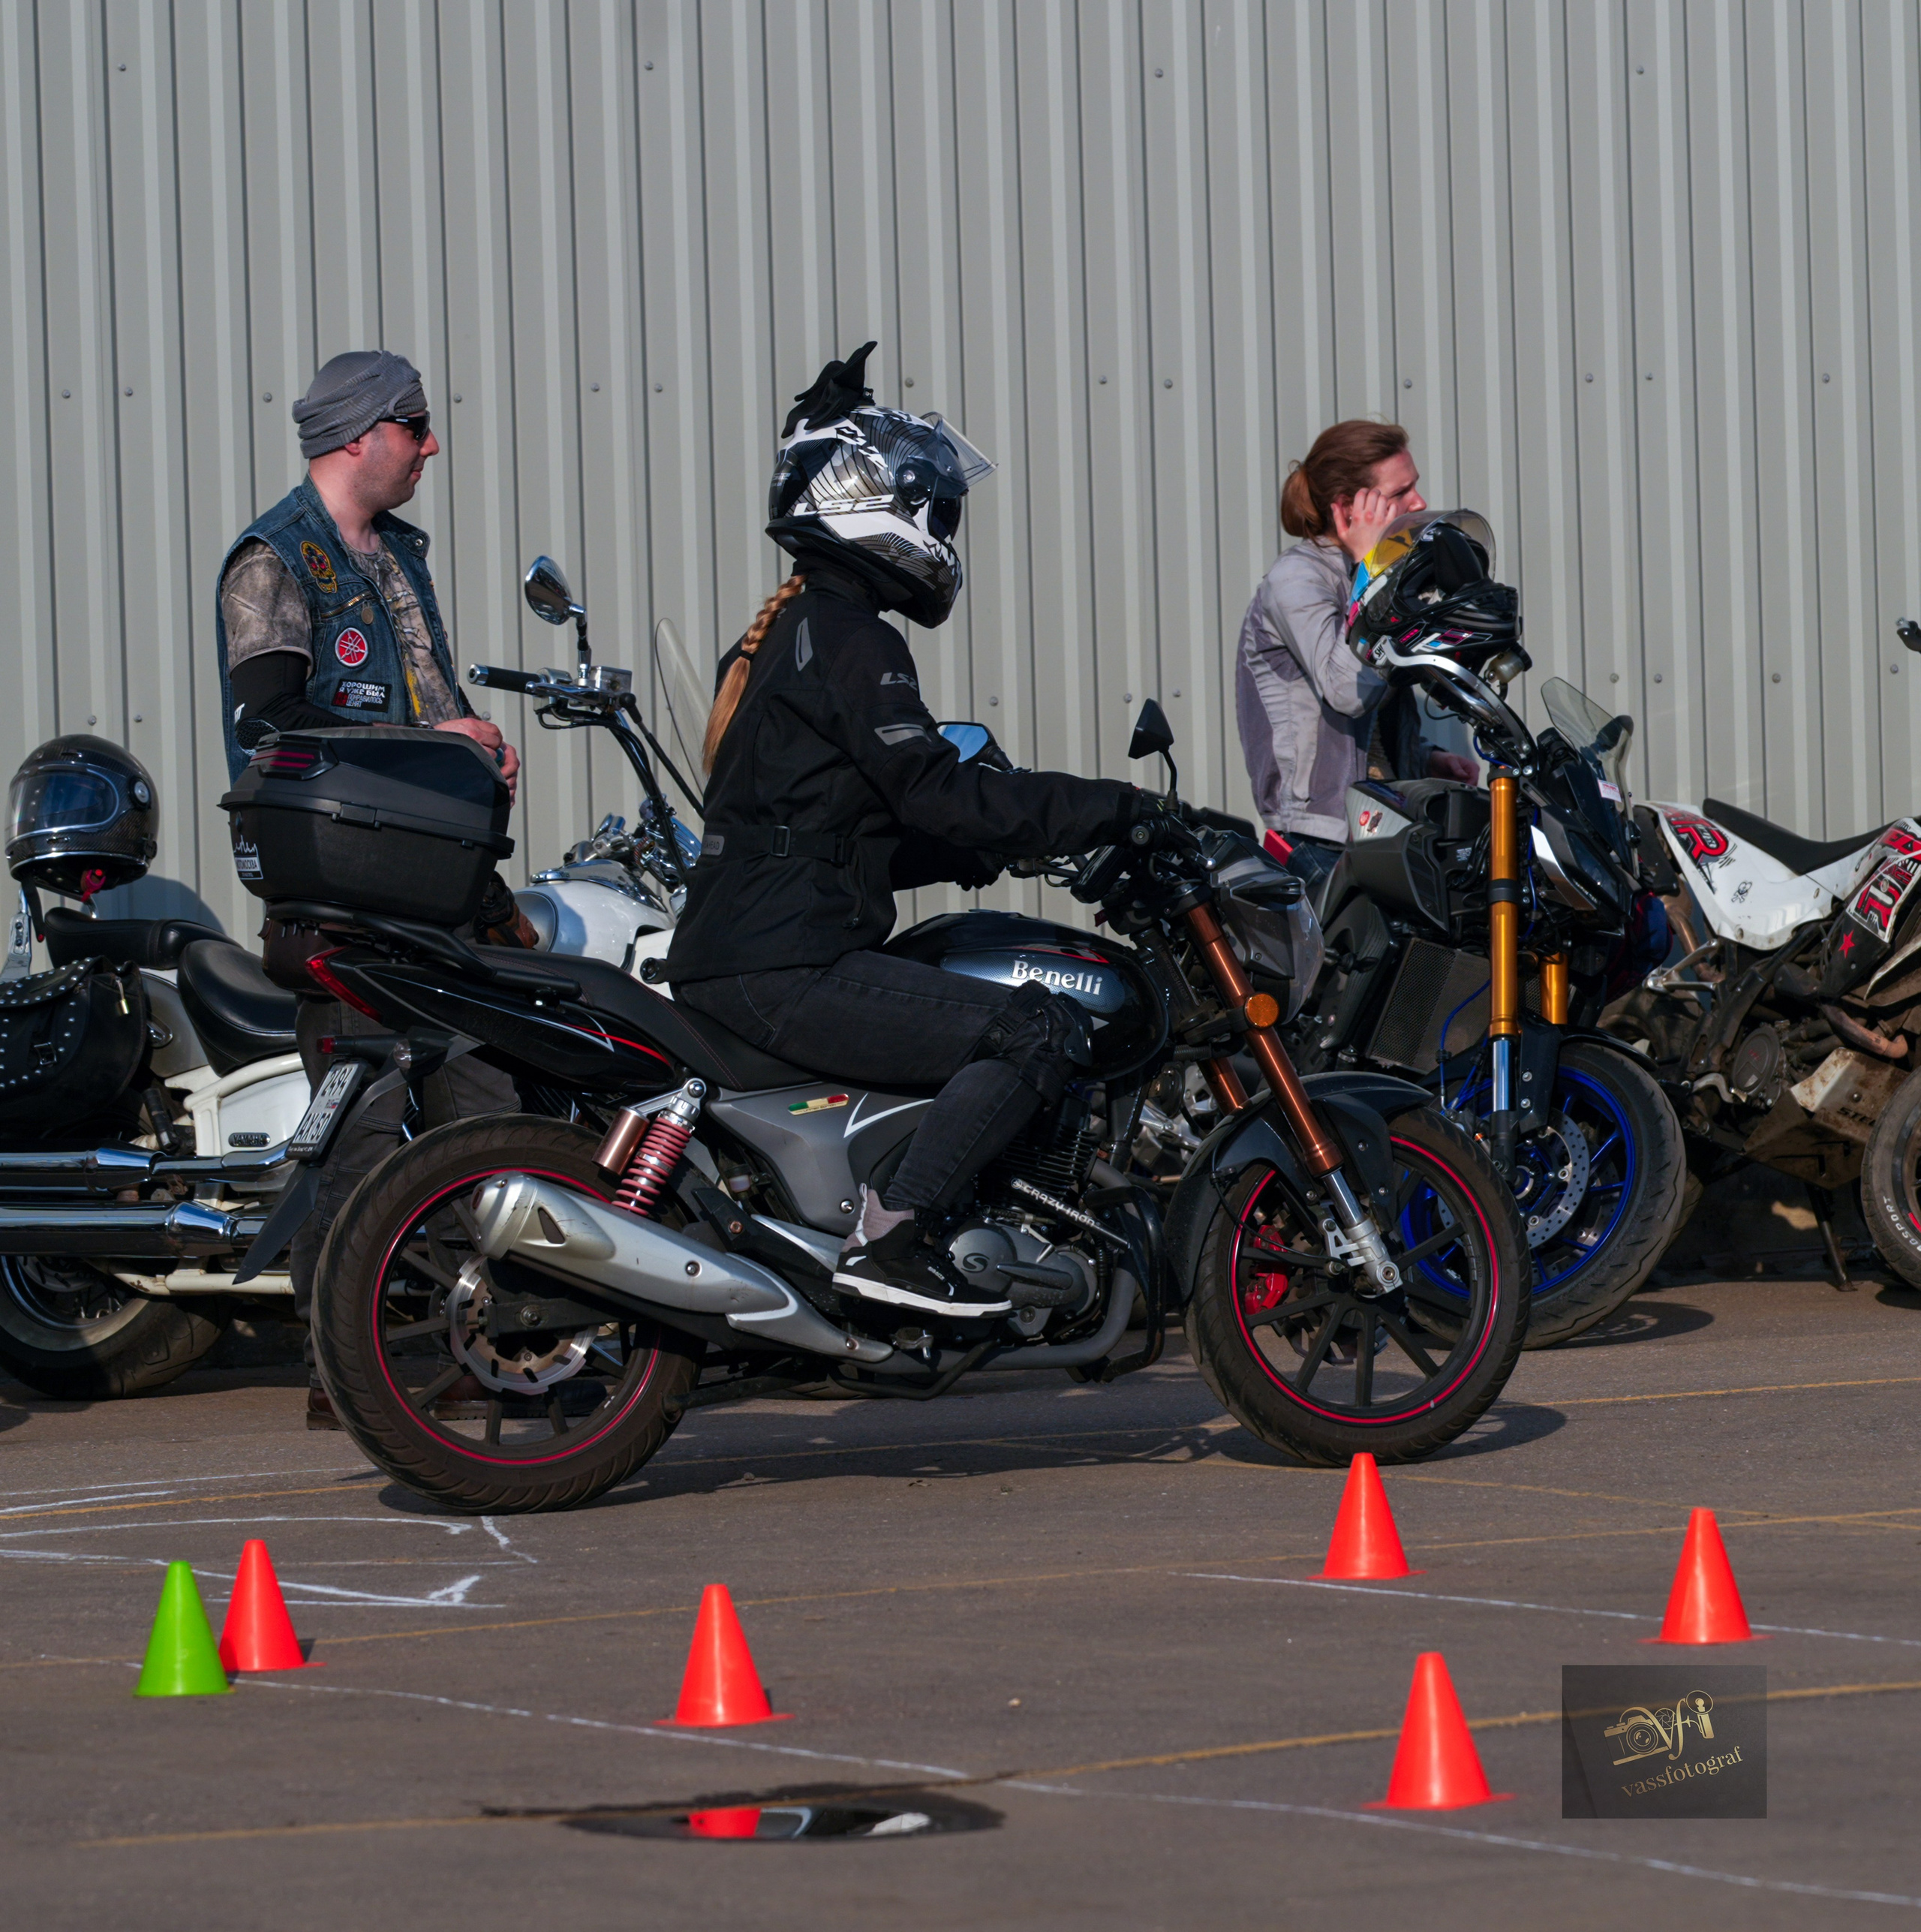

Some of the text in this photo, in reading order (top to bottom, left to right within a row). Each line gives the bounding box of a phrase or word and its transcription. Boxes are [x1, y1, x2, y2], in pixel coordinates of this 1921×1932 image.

[793, 494, 894, 516] LS2
[342, 681, 386, 692] ХОРОШИМ
[880, 672, 918, 691] LS2
[365, 690, 386, 698] БЫЛ
[1012, 959, 1103, 996] Benelli
